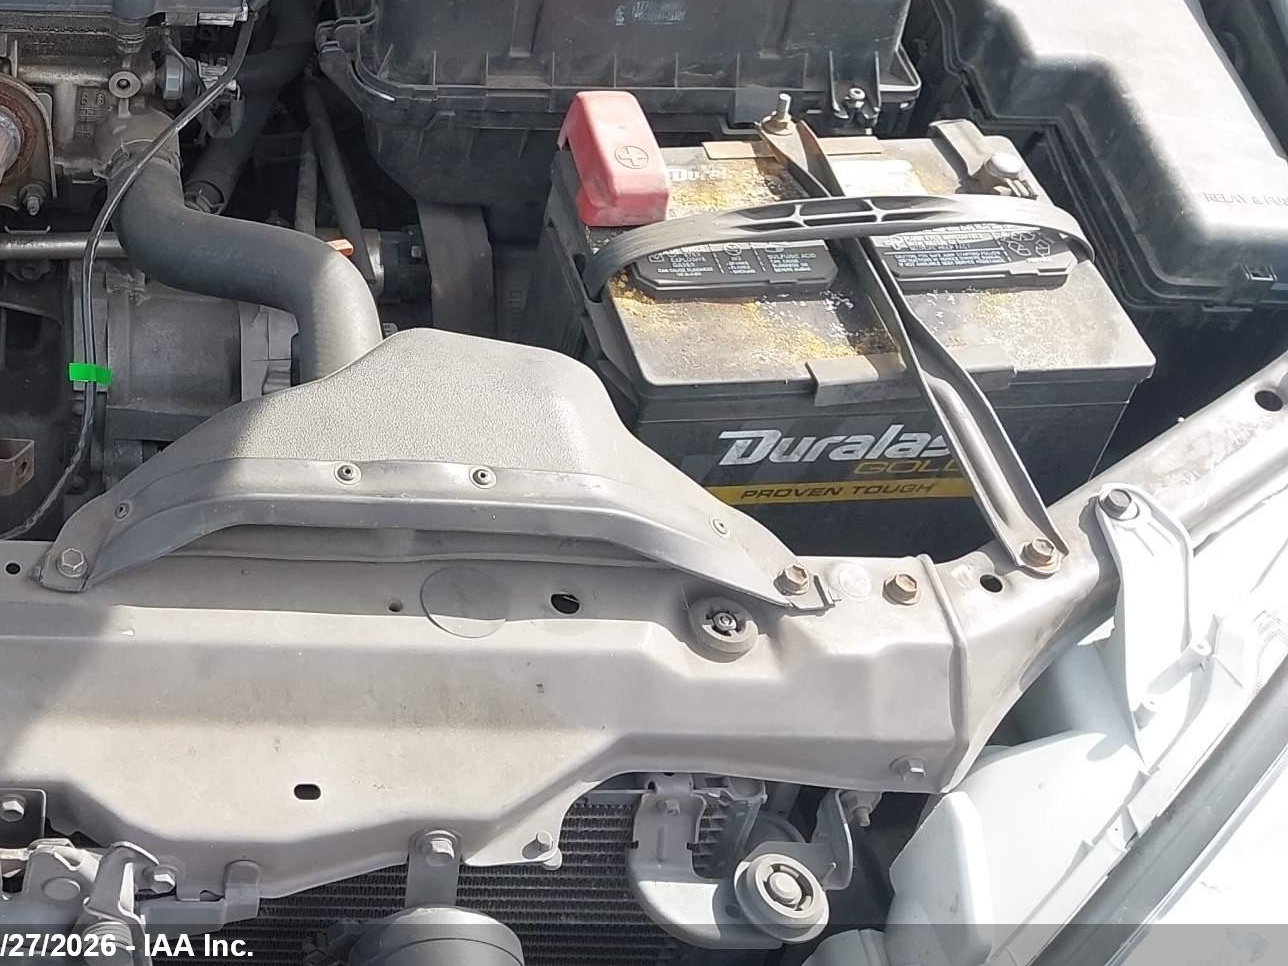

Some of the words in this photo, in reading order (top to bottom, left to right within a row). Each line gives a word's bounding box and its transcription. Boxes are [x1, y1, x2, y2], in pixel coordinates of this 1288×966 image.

[718, 424, 952, 466] Duralas
[740, 484, 846, 500] PROVEN
[851, 481, 936, 496] TOUGH
